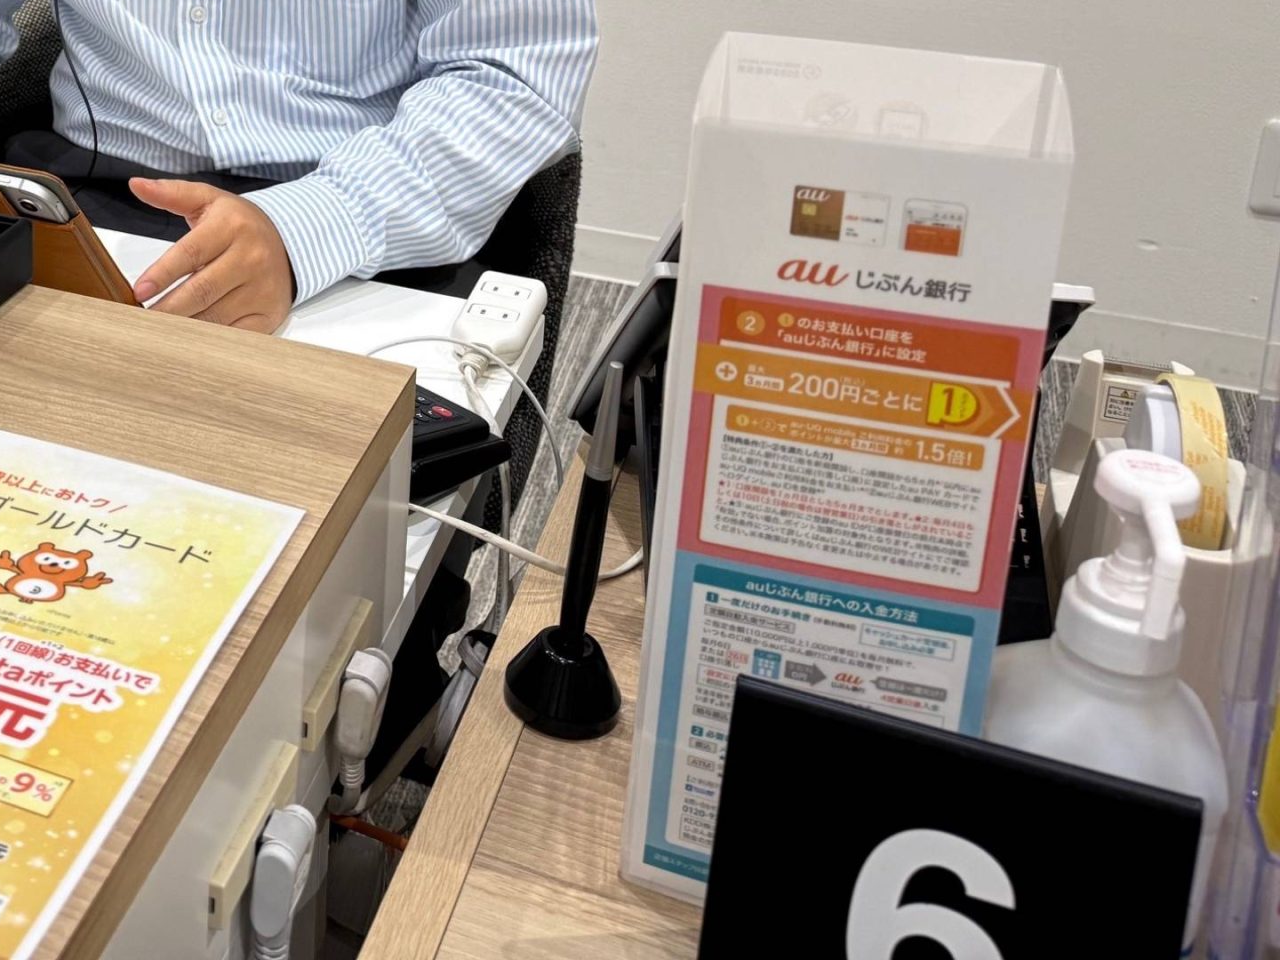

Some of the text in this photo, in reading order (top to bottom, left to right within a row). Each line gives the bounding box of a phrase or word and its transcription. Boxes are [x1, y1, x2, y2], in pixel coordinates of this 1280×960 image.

[796, 186, 831, 203] au
[776, 256, 972, 304] au じぶん銀行
[743, 315, 757, 331] 2
[776, 329, 928, 364] 「auじぶん銀行」に設定
[788, 371, 924, 414] 200円ごとに
[938, 385, 955, 417] 1
[913, 439, 973, 467] 1.5倍!
[745, 579, 918, 623] auじぶん銀行への入金方法
[834, 670, 863, 685] au
[847, 828, 1018, 960] 6
